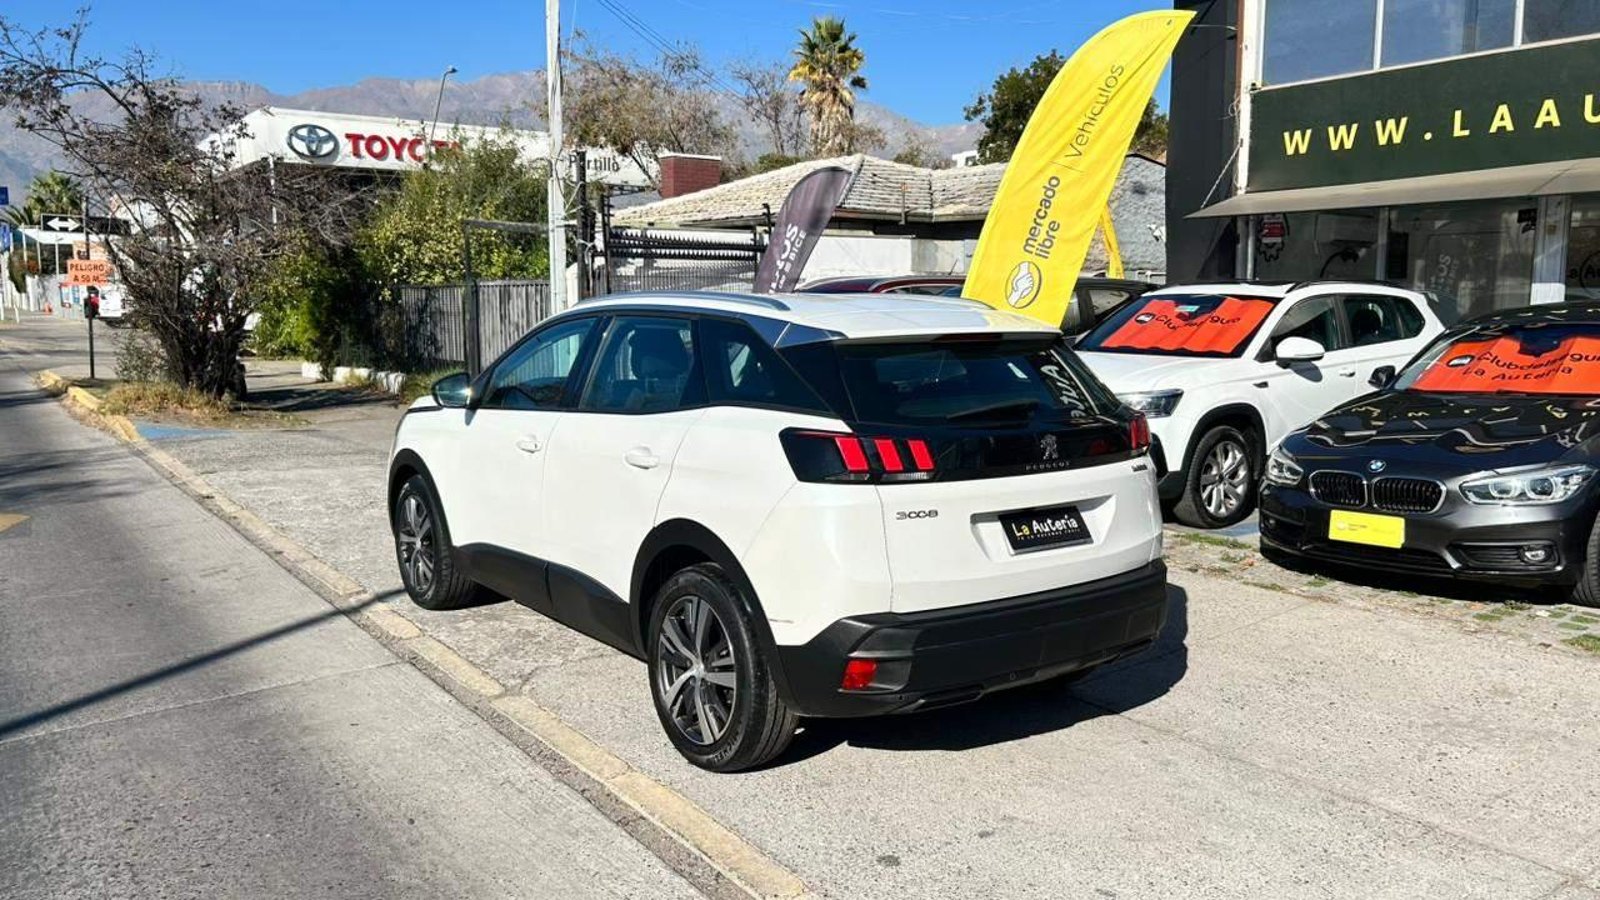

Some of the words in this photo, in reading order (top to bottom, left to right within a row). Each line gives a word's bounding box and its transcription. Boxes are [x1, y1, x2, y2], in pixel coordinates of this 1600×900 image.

[568, 153, 620, 172] Prtillo
[1023, 175, 1061, 254] mercado
[1034, 219, 1061, 260] libre
[70, 263, 105, 272] PELIGRO
[1011, 522, 1030, 537] La
[1032, 514, 1079, 534] Auteria
